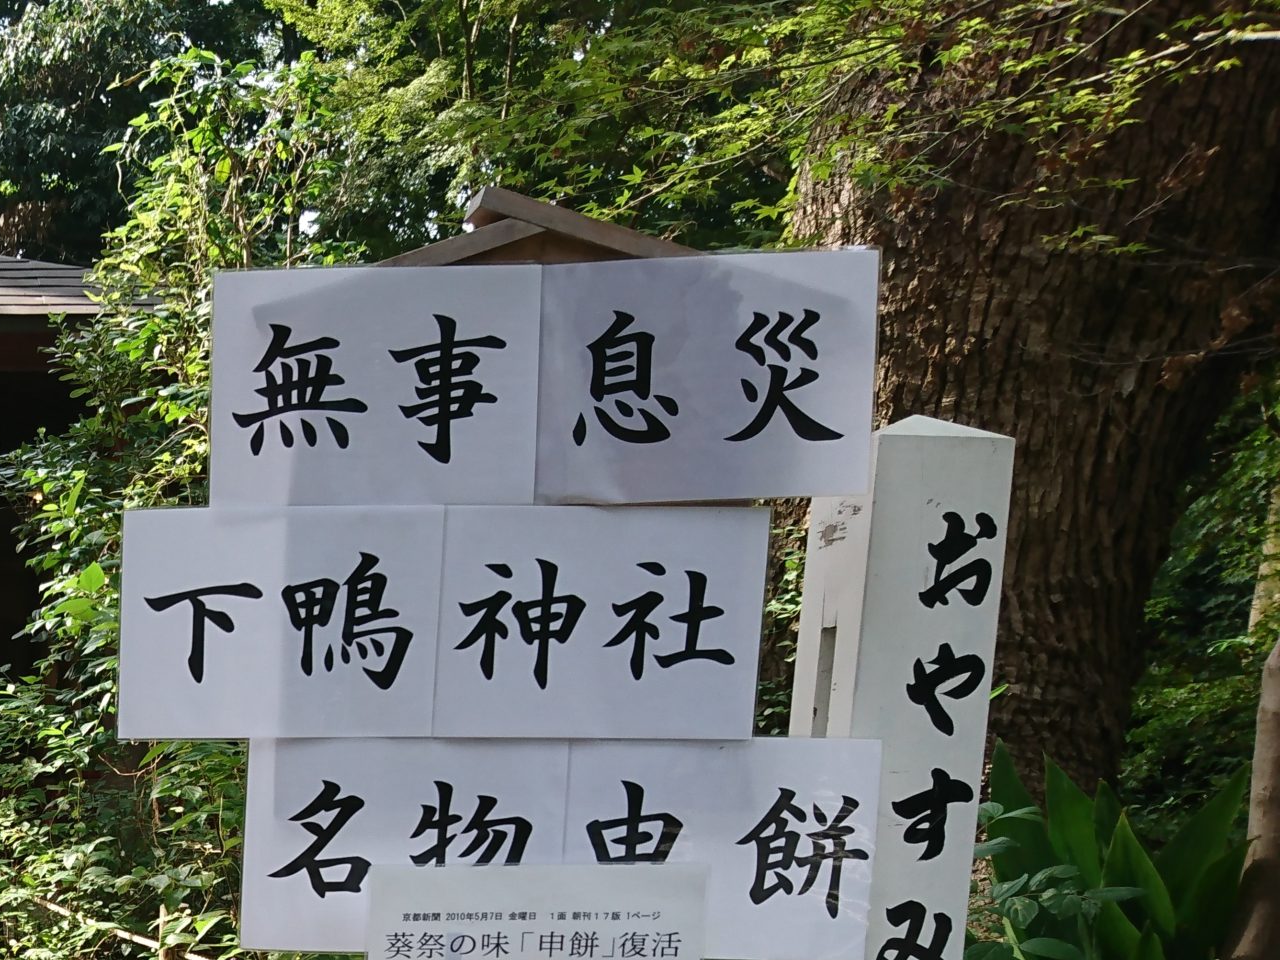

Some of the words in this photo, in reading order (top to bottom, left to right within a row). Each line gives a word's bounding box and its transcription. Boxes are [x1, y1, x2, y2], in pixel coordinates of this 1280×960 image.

[231, 308, 845, 465] 無事息災
[143, 551, 736, 691] 下鴨神社
[385, 930, 683, 960] 葵祭の味「申餅」復活
[402, 912, 442, 922] 京都新聞
[445, 911, 503, 921] 2010年5月7日
[507, 911, 537, 921] 金曜日
